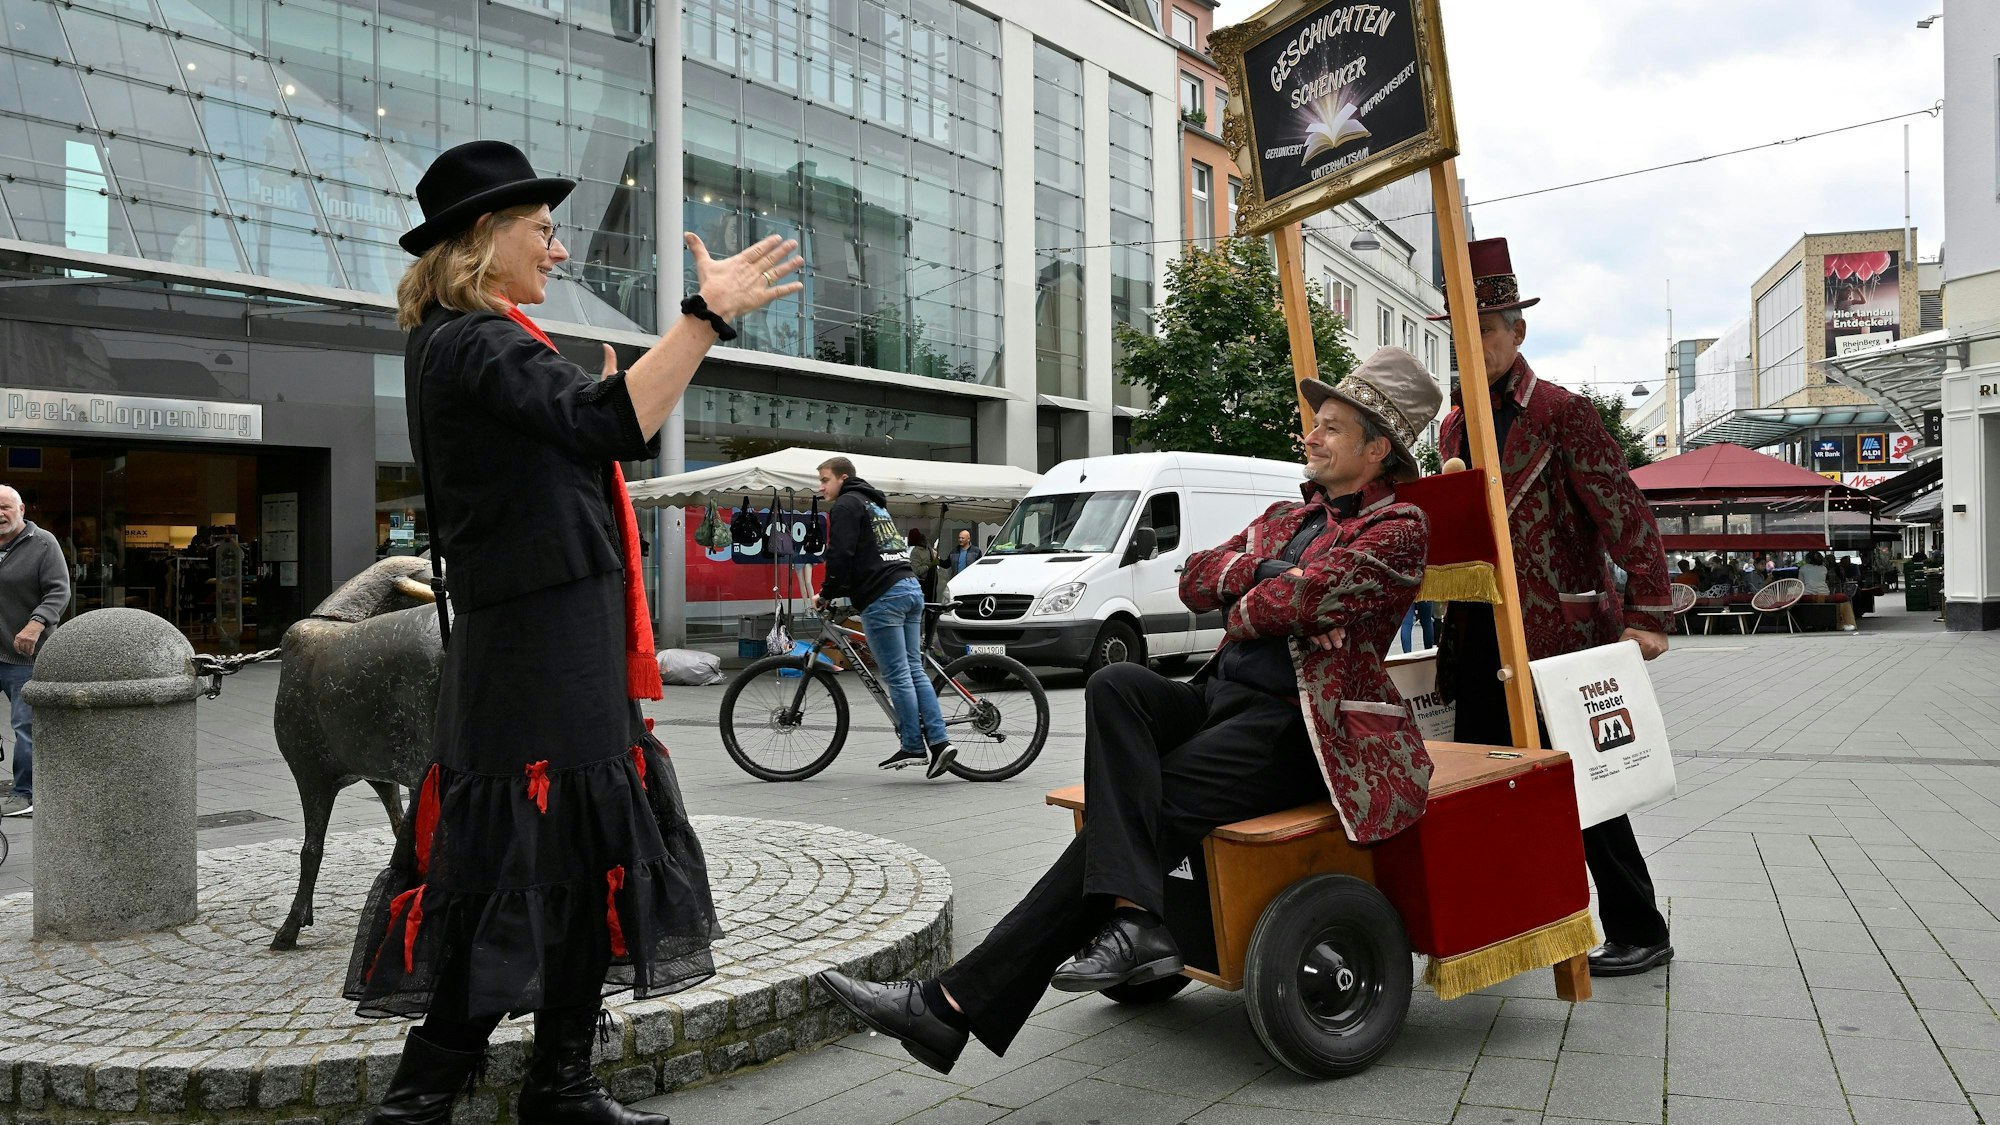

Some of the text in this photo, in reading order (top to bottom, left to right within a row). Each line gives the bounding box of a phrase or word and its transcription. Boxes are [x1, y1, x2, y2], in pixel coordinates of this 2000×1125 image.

[1270, 3, 1396, 92] GESCHICHTEN
[1291, 55, 1367, 109] SCHENKER
[1359, 60, 1415, 117] IMPROVISIERT
[1264, 143, 1304, 160] GEFLUNKERT
[1310, 146, 1370, 180] UNTERHALTSAM
[1833, 308, 1893, 318] Hier landen
[1833, 318, 1893, 328] Entdecker!
[1842, 339, 1881, 348] RheinBerg
[1979, 383, 1998, 396] RI
[8, 393, 76, 421] Peek
[90, 398, 251, 437] Cloppenburg
[1579, 677, 1619, 701] THEAS
[1584, 695, 1624, 714] Theater
